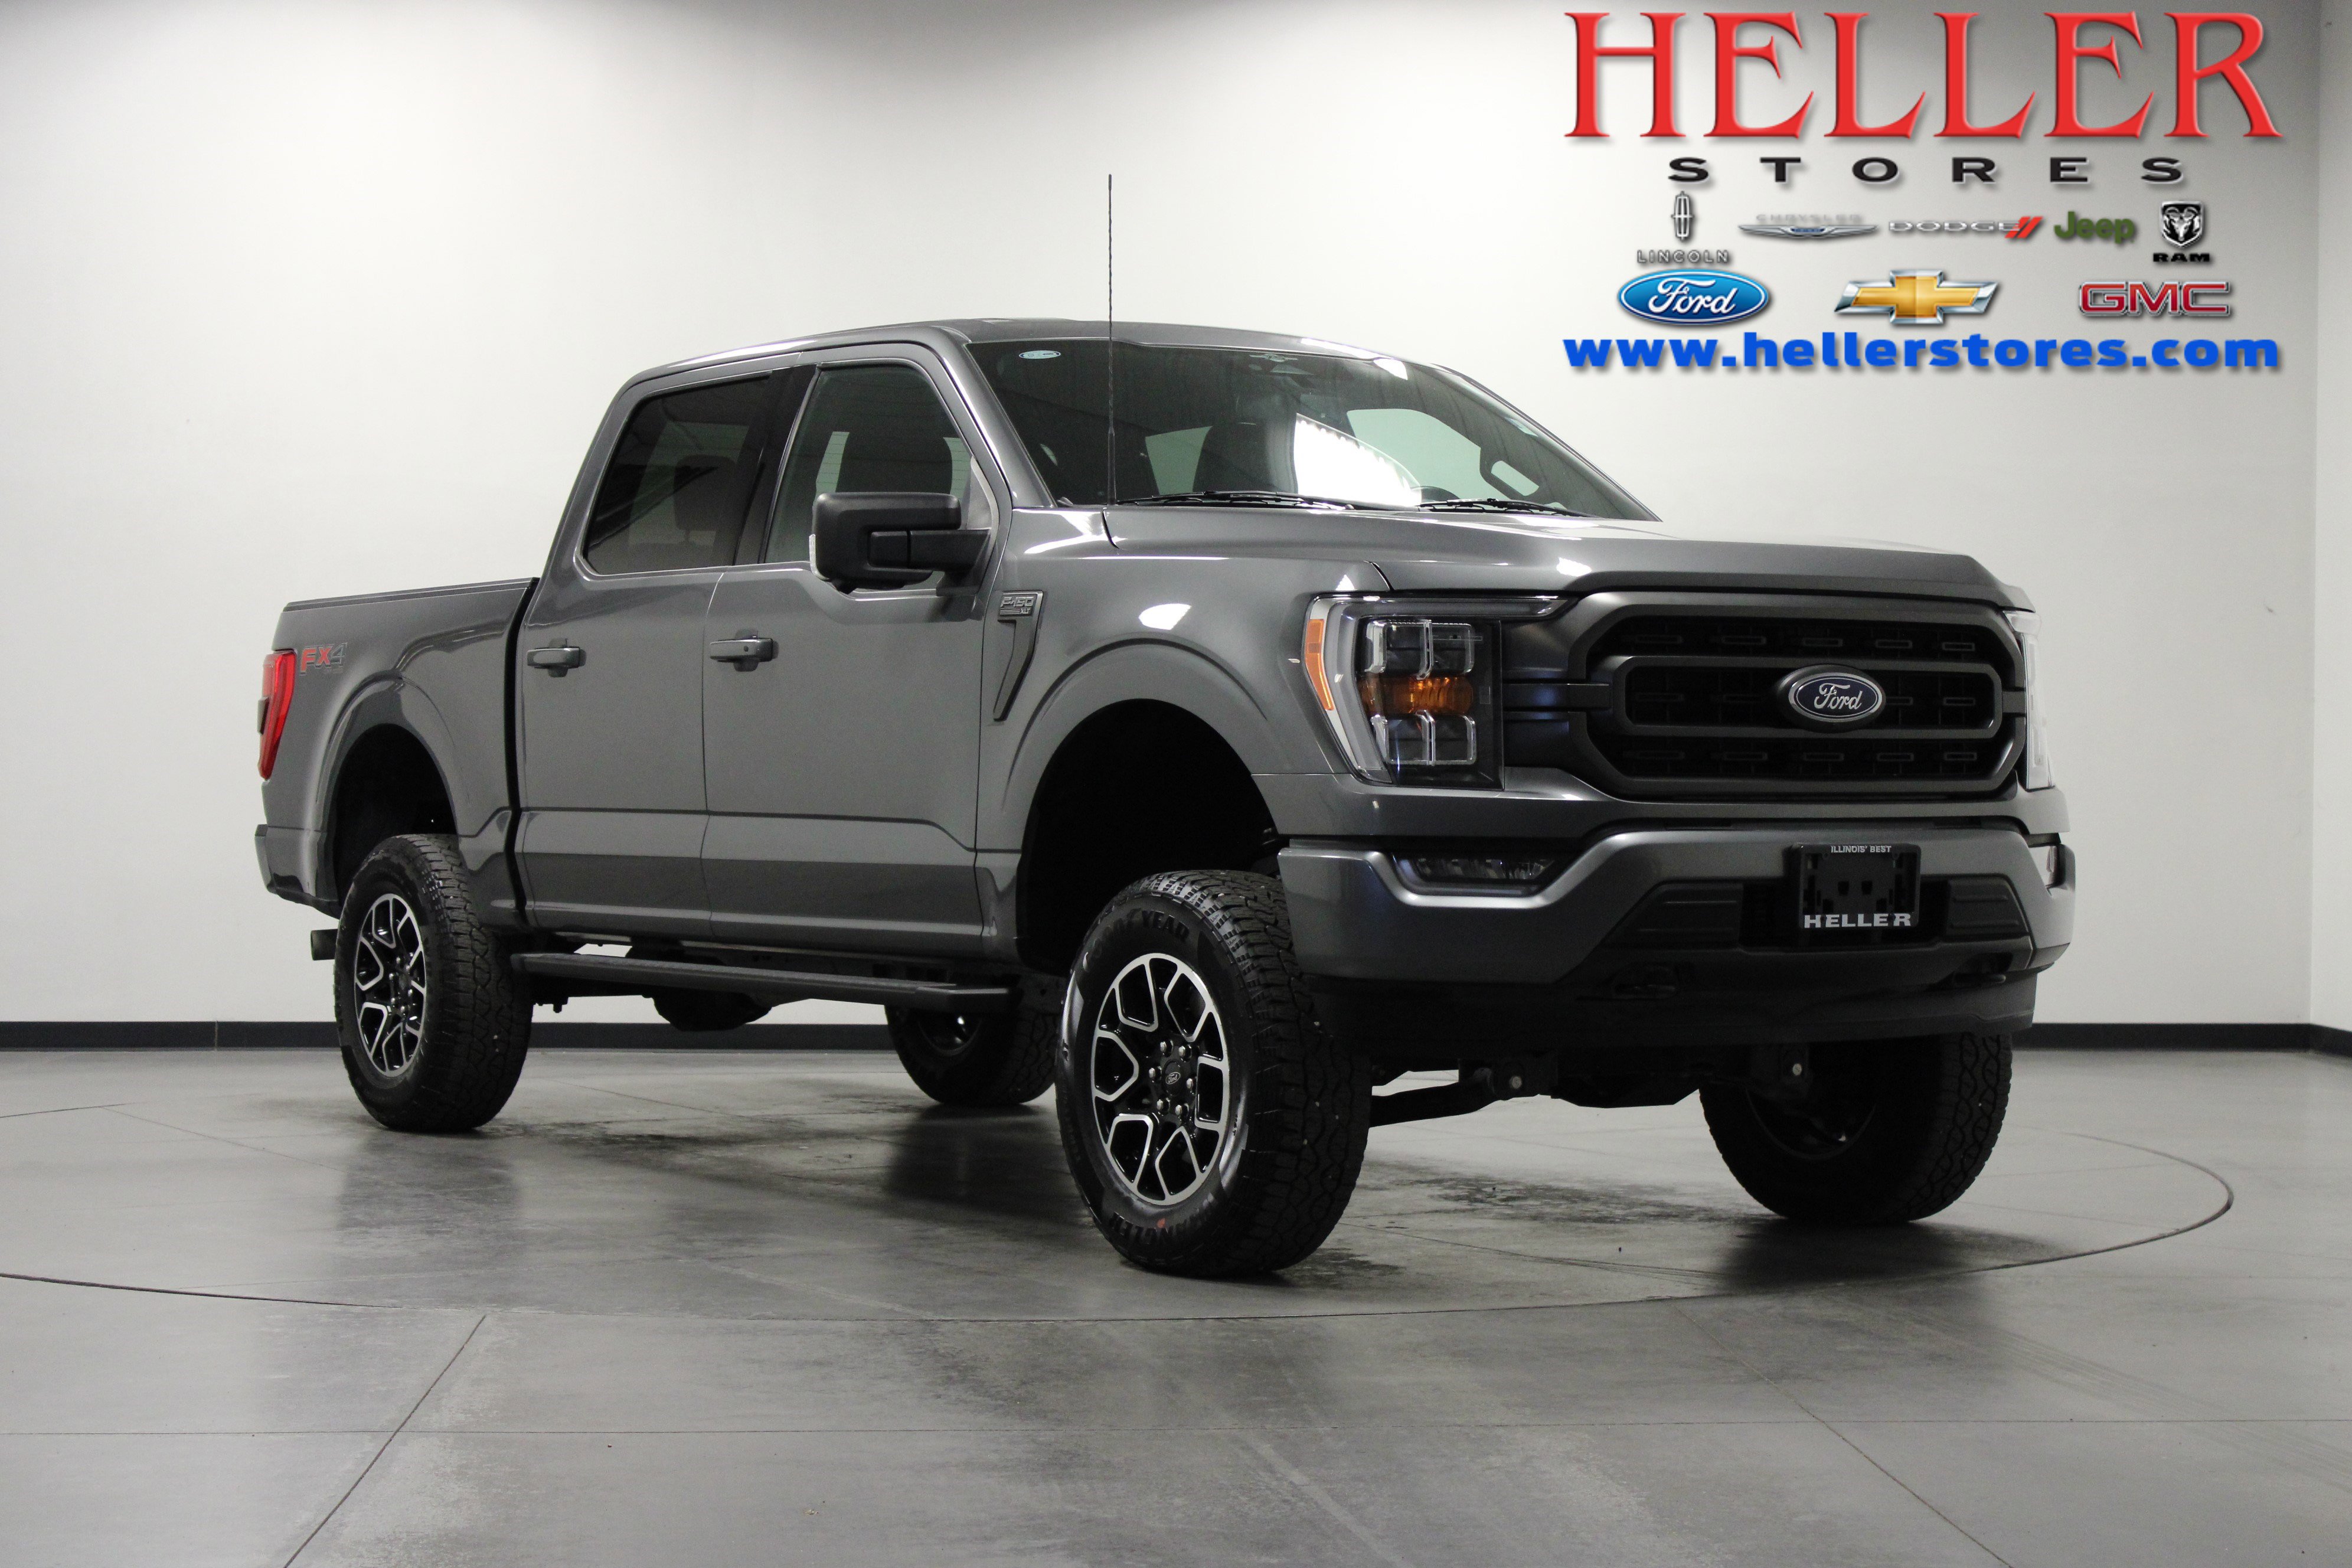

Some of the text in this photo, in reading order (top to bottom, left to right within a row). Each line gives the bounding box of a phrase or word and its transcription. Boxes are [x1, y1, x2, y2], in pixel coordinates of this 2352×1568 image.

[1000, 596, 1034, 607] F-150
[299, 642, 347, 675] FX4
[1814, 682, 1863, 710] Ford
[1830, 845, 1867, 854] ILLINOIS'
[1804, 913, 1911, 928] HELLER
